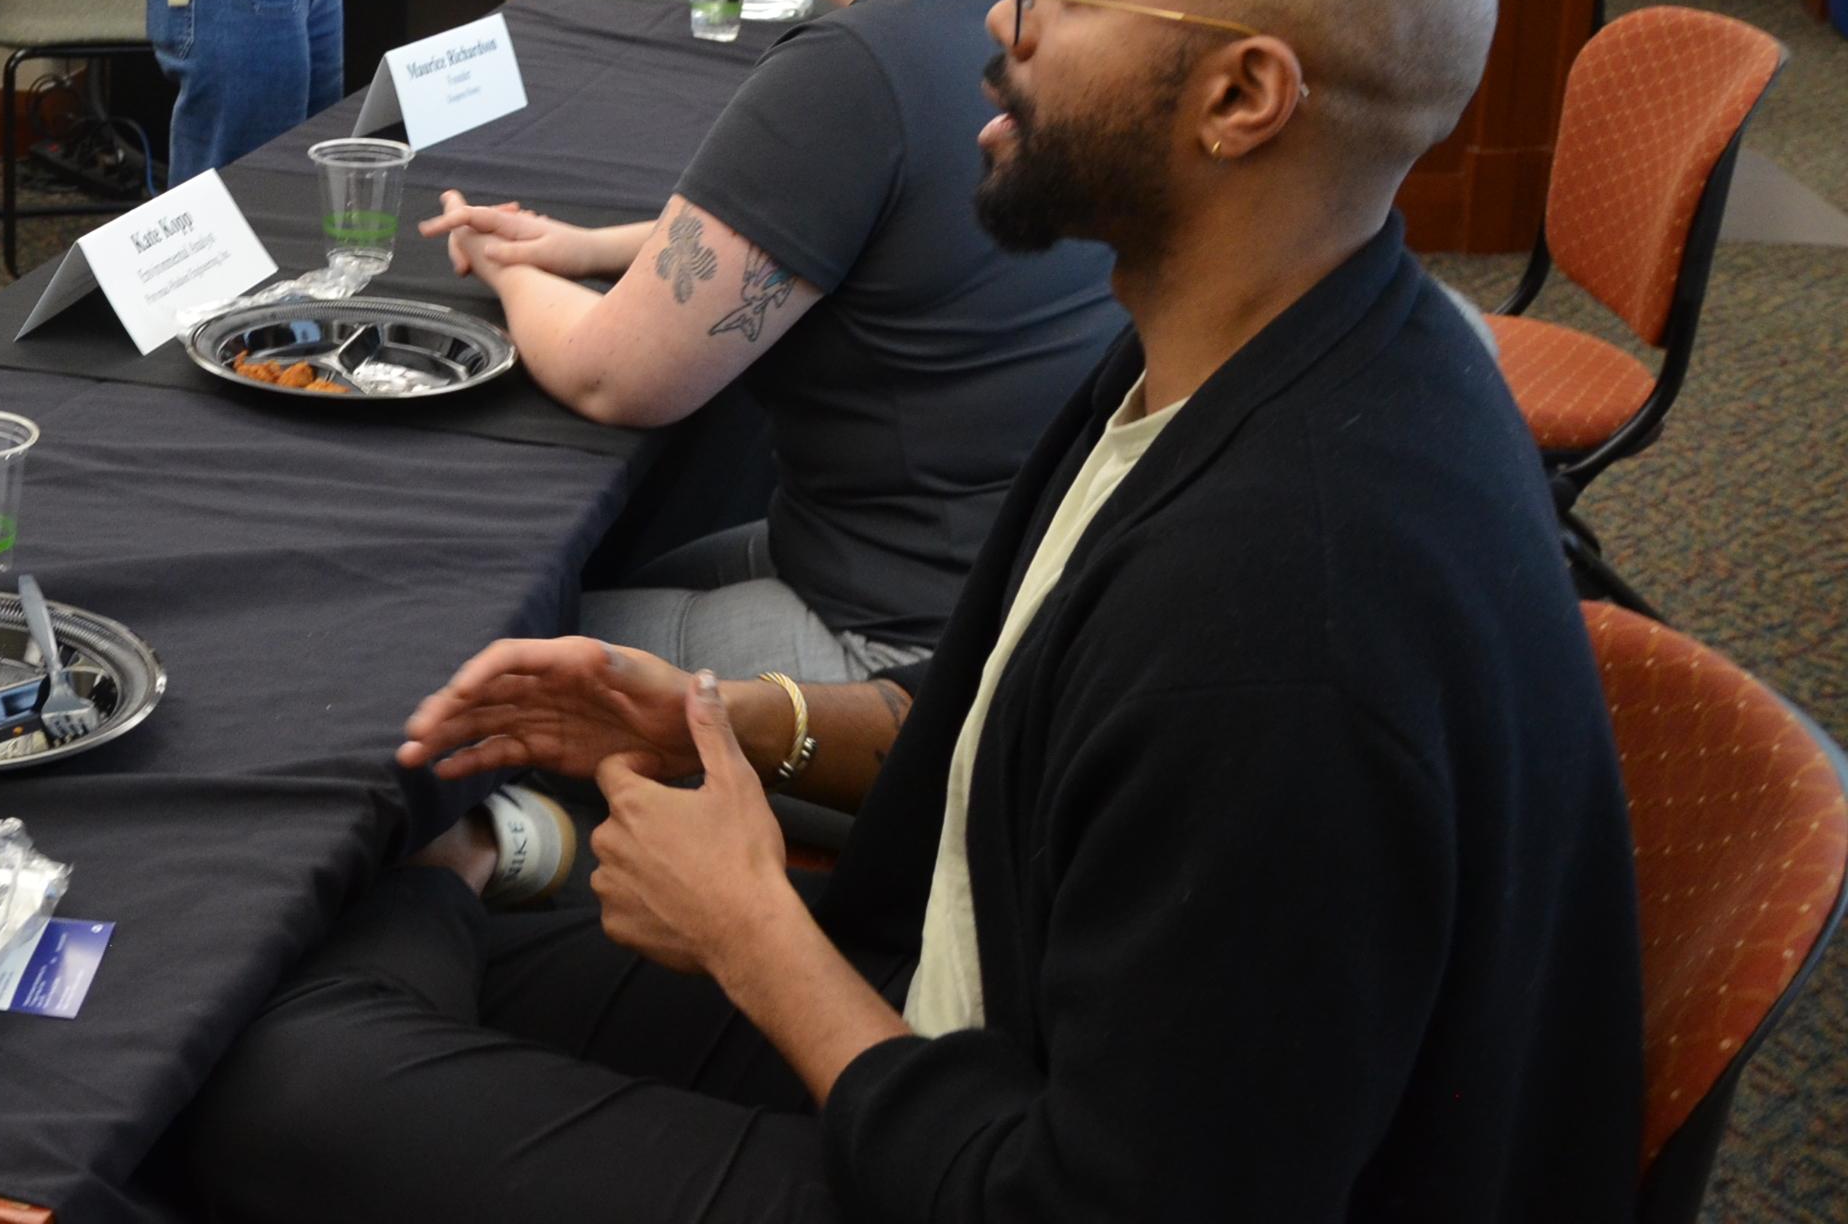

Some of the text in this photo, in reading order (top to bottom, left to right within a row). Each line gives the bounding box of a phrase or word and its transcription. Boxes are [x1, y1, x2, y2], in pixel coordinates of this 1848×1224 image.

[407, 38, 497, 79] Maurice Richardson
[130, 229, 162, 254] Kate
